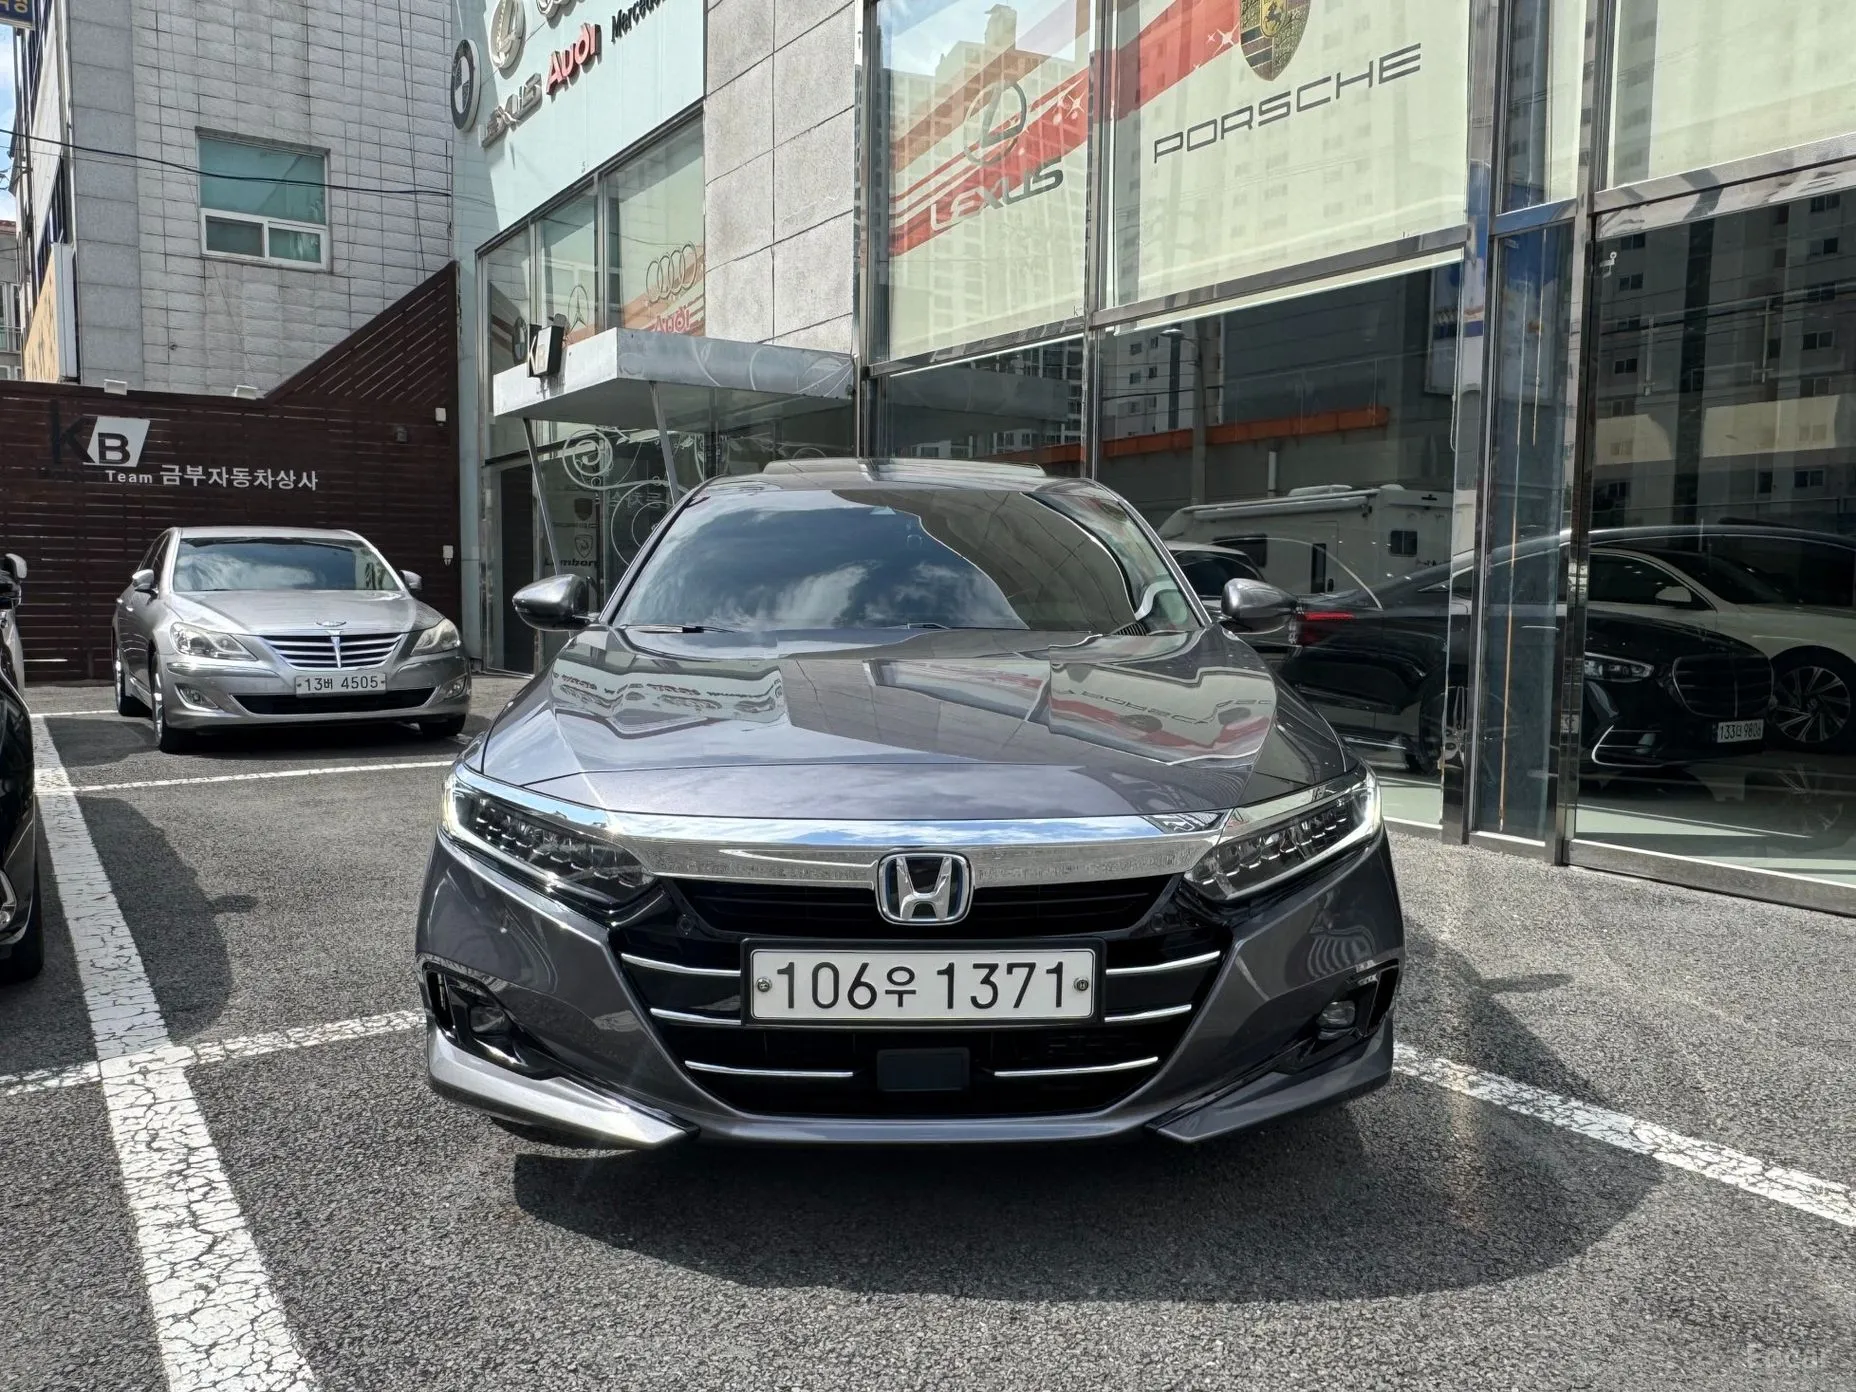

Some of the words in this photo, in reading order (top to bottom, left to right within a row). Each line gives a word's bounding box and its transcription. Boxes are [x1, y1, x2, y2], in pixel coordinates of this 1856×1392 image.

[546, 22, 602, 95] Audi
[1154, 42, 1421, 164] PORSCHE
[930, 155, 1064, 231] LEXUS
[105, 469, 153, 484] Team
[159, 463, 319, 491] 금부자동차상사
[304, 678, 333, 692] 13버
[340, 675, 379, 690] 4505
[936, 961, 1063, 1010] 1371
